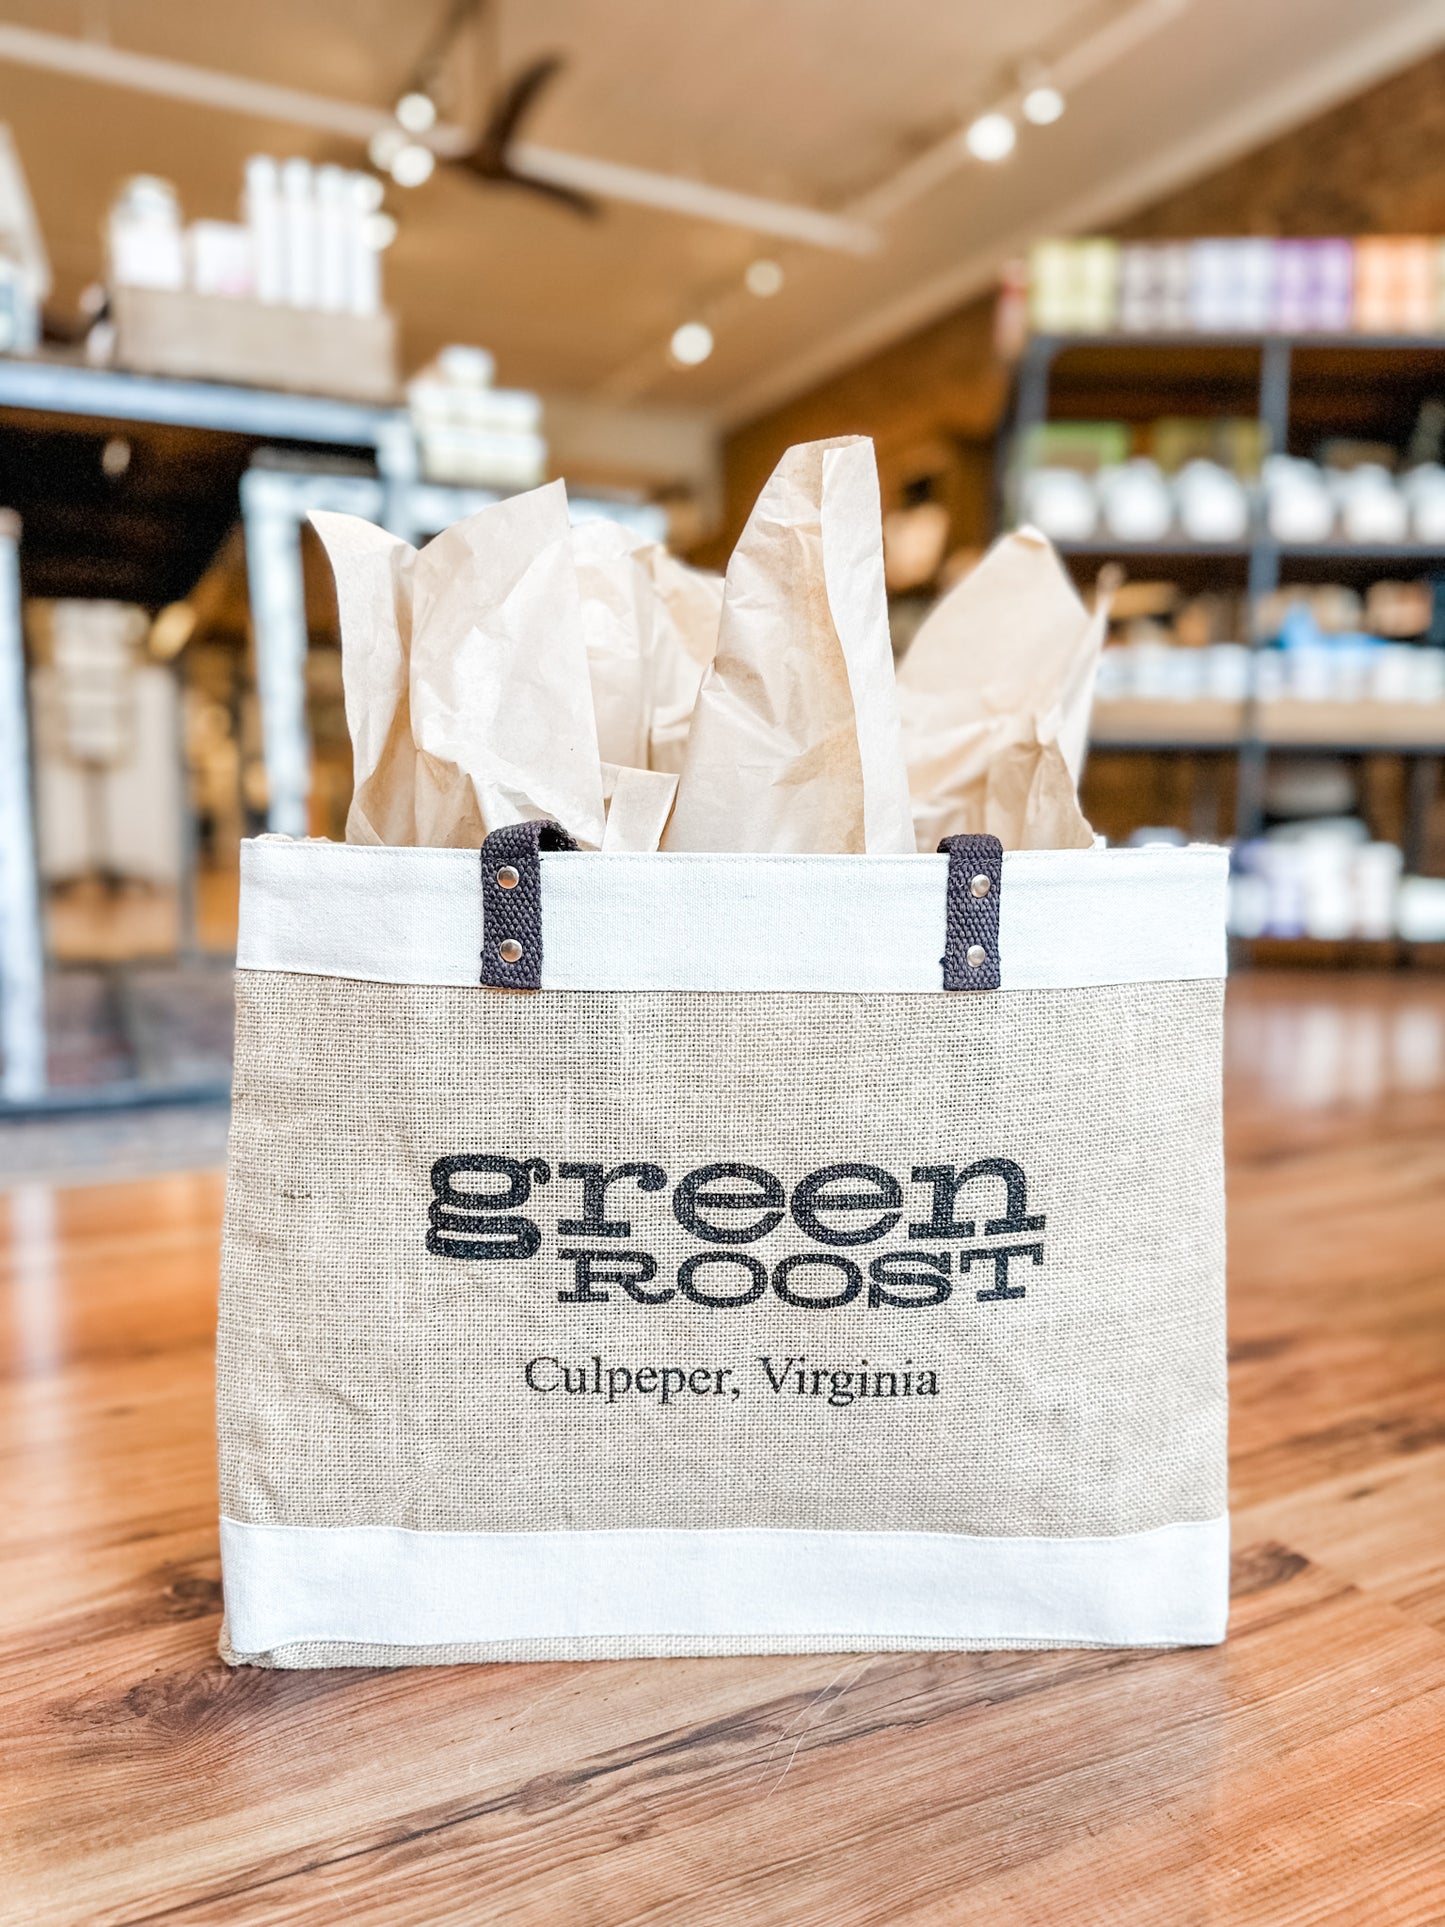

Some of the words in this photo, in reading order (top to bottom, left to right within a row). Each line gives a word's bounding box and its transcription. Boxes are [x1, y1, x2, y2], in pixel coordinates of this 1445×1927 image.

[425, 1153, 1047, 1260] green
[557, 1242, 1045, 1310] ROOST
[524, 1356, 741, 1405] Culpeper,
[757, 1356, 941, 1408] Virginia
